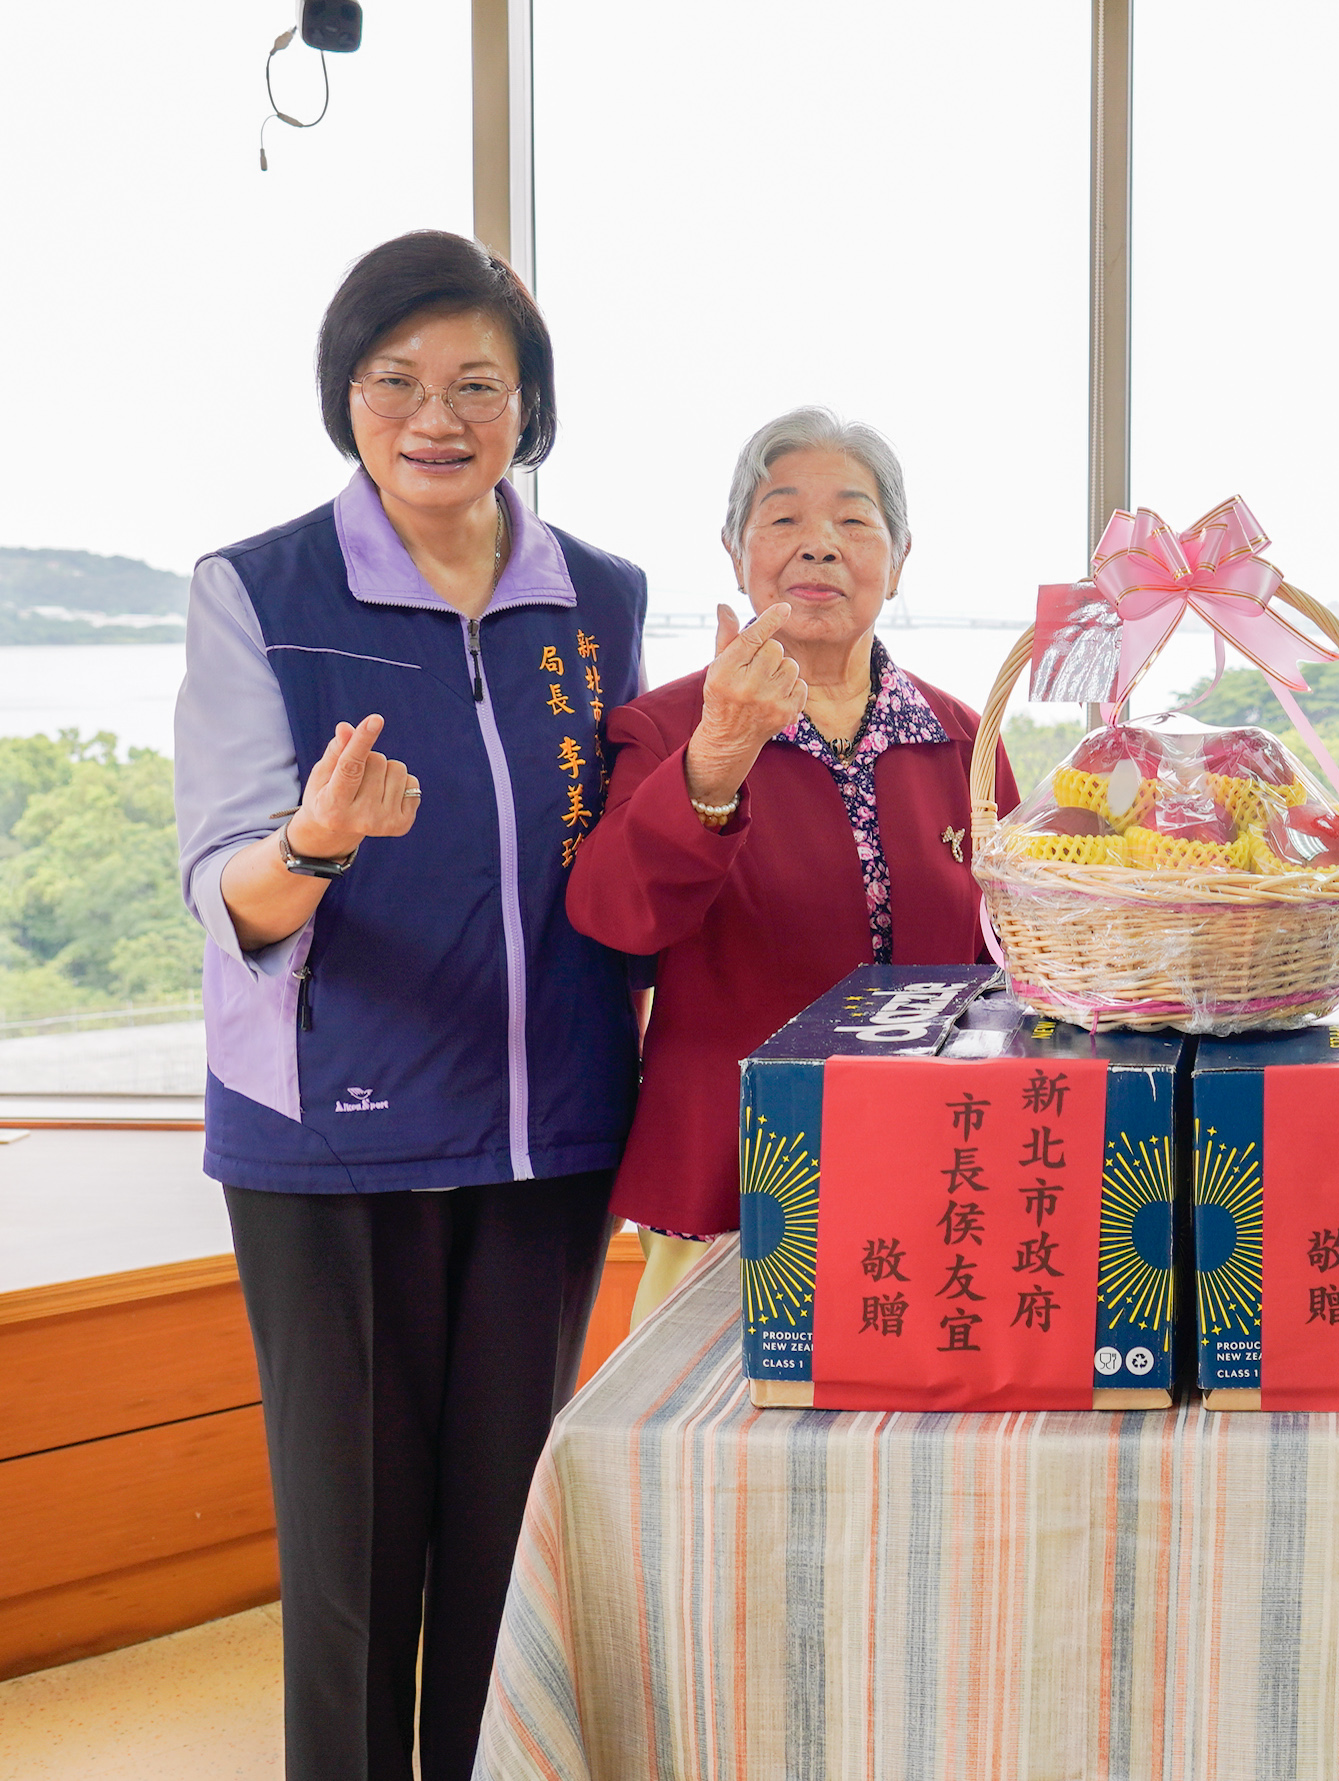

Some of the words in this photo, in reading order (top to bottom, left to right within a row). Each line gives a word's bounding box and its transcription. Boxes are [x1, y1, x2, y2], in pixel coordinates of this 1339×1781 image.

[539, 646, 575, 715] 局長
[1010, 1068, 1071, 1332] 新北市政府
[935, 1092, 991, 1352] 市長侯友宜
[859, 1238, 911, 1337] 敬贈
[763, 1331, 813, 1340] PRODUCT
[763, 1342, 787, 1351] NEW
[1217, 1341, 1261, 1350] PRODUC
[1217, 1353, 1241, 1361] NEW
[763, 1359, 795, 1368] CLASS
[799, 1360, 803, 1368] 1
[1217, 1369, 1250, 1378] CLASS
[1254, 1369, 1258, 1377] 1
